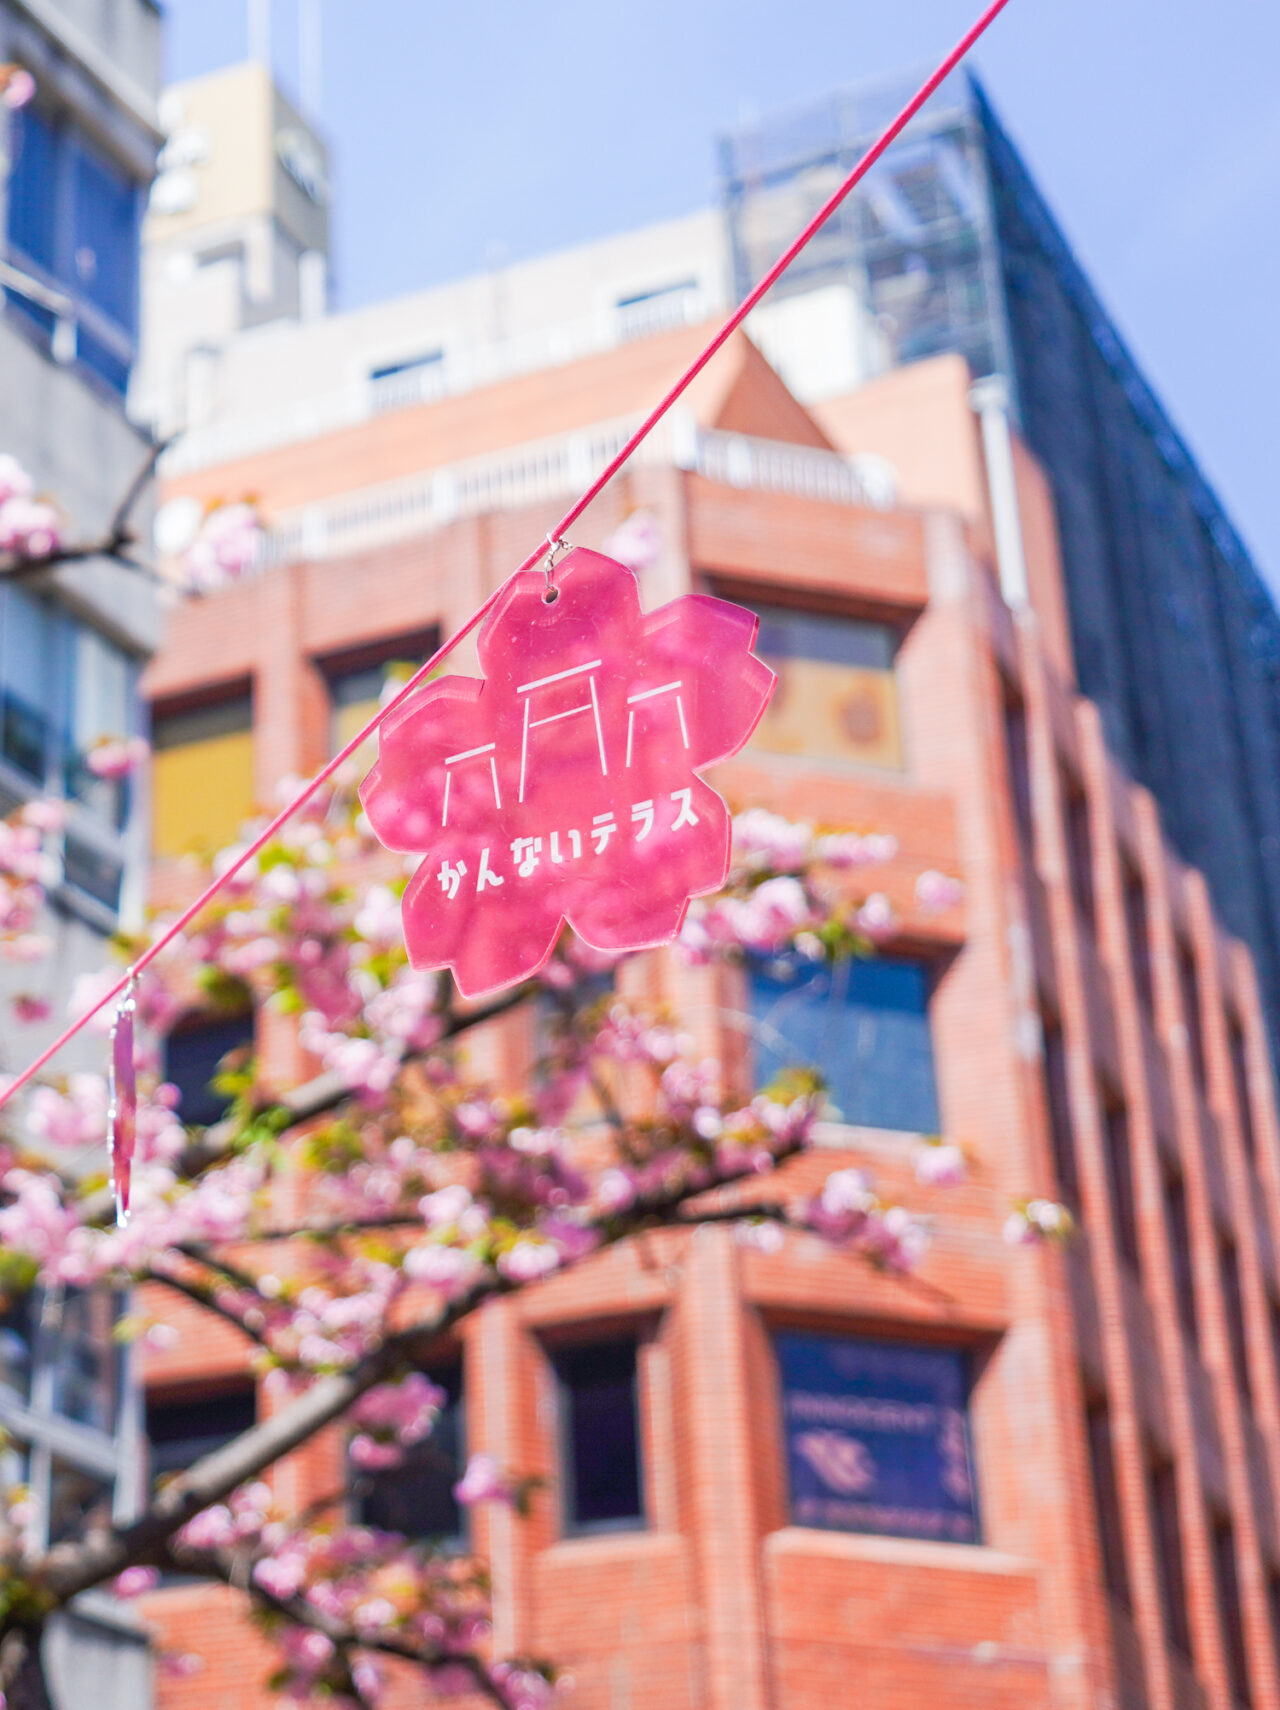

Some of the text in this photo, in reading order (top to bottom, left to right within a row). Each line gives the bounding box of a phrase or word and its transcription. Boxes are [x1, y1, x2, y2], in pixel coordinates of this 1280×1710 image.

[436, 787, 699, 900] かんないテラス
